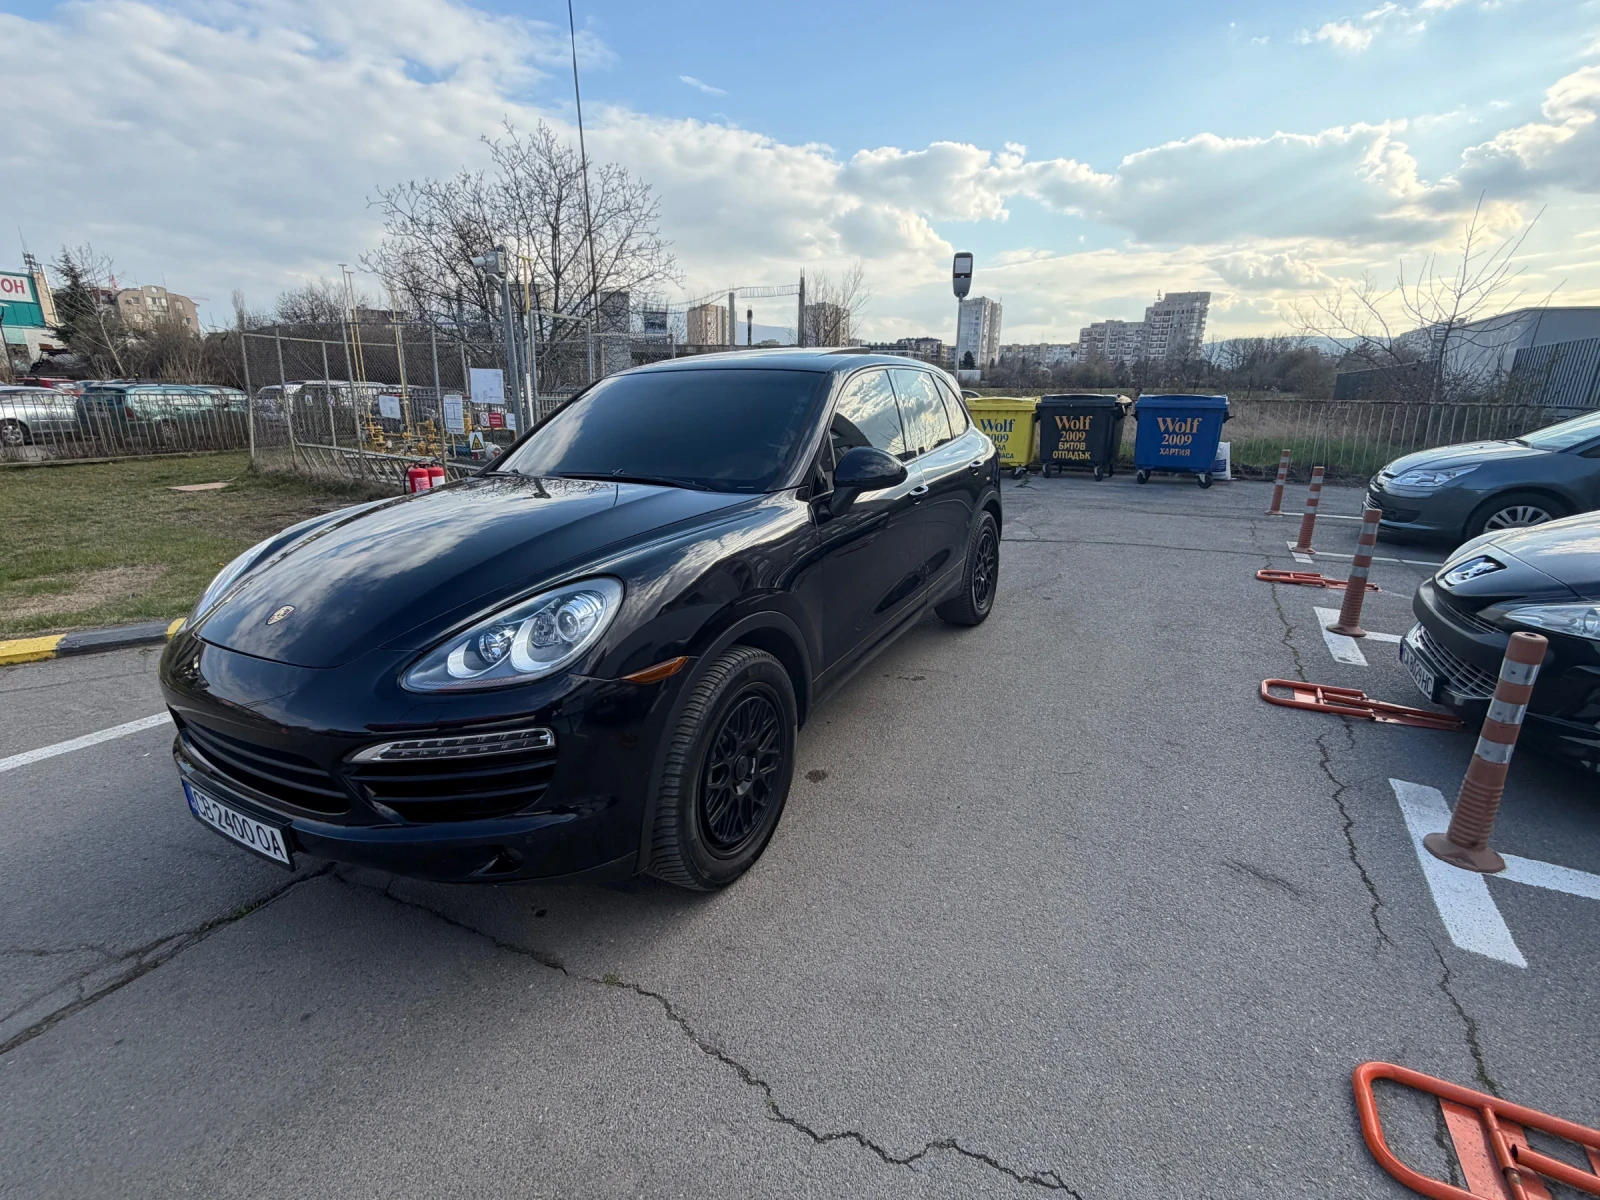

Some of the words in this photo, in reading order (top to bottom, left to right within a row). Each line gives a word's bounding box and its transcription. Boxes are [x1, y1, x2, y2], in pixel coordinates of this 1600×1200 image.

[980, 418, 1015, 432] Wolf
[1054, 415, 1093, 430] Wolf
[1157, 417, 1202, 433] Wolf
[986, 433, 1009, 443] 009
[1060, 431, 1086, 441] 2009
[1161, 434, 1192, 445] 2009
[1058, 441, 1086, 450] БИТОВ
[1052, 450, 1091, 460] ОТПАДЪК
[1159, 447, 1191, 456] ХАРТИЯ
